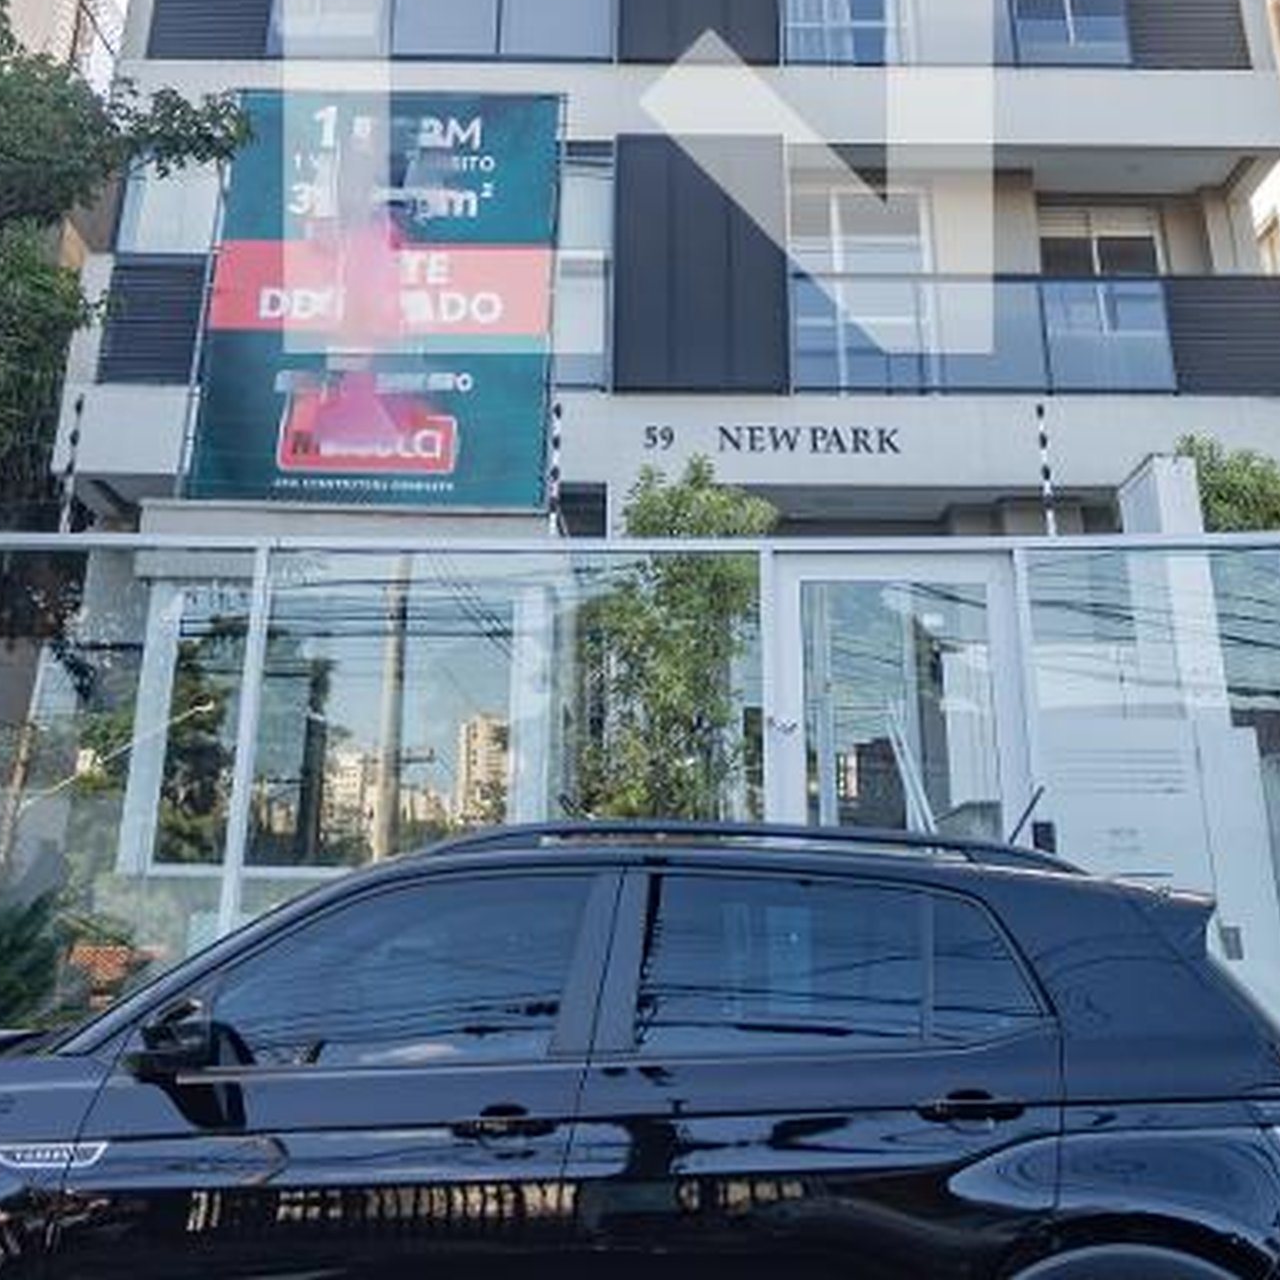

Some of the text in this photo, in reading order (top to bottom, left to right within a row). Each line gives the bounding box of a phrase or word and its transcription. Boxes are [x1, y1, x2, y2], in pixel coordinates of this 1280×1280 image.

[643, 425, 901, 454] 59 NEW PARK
